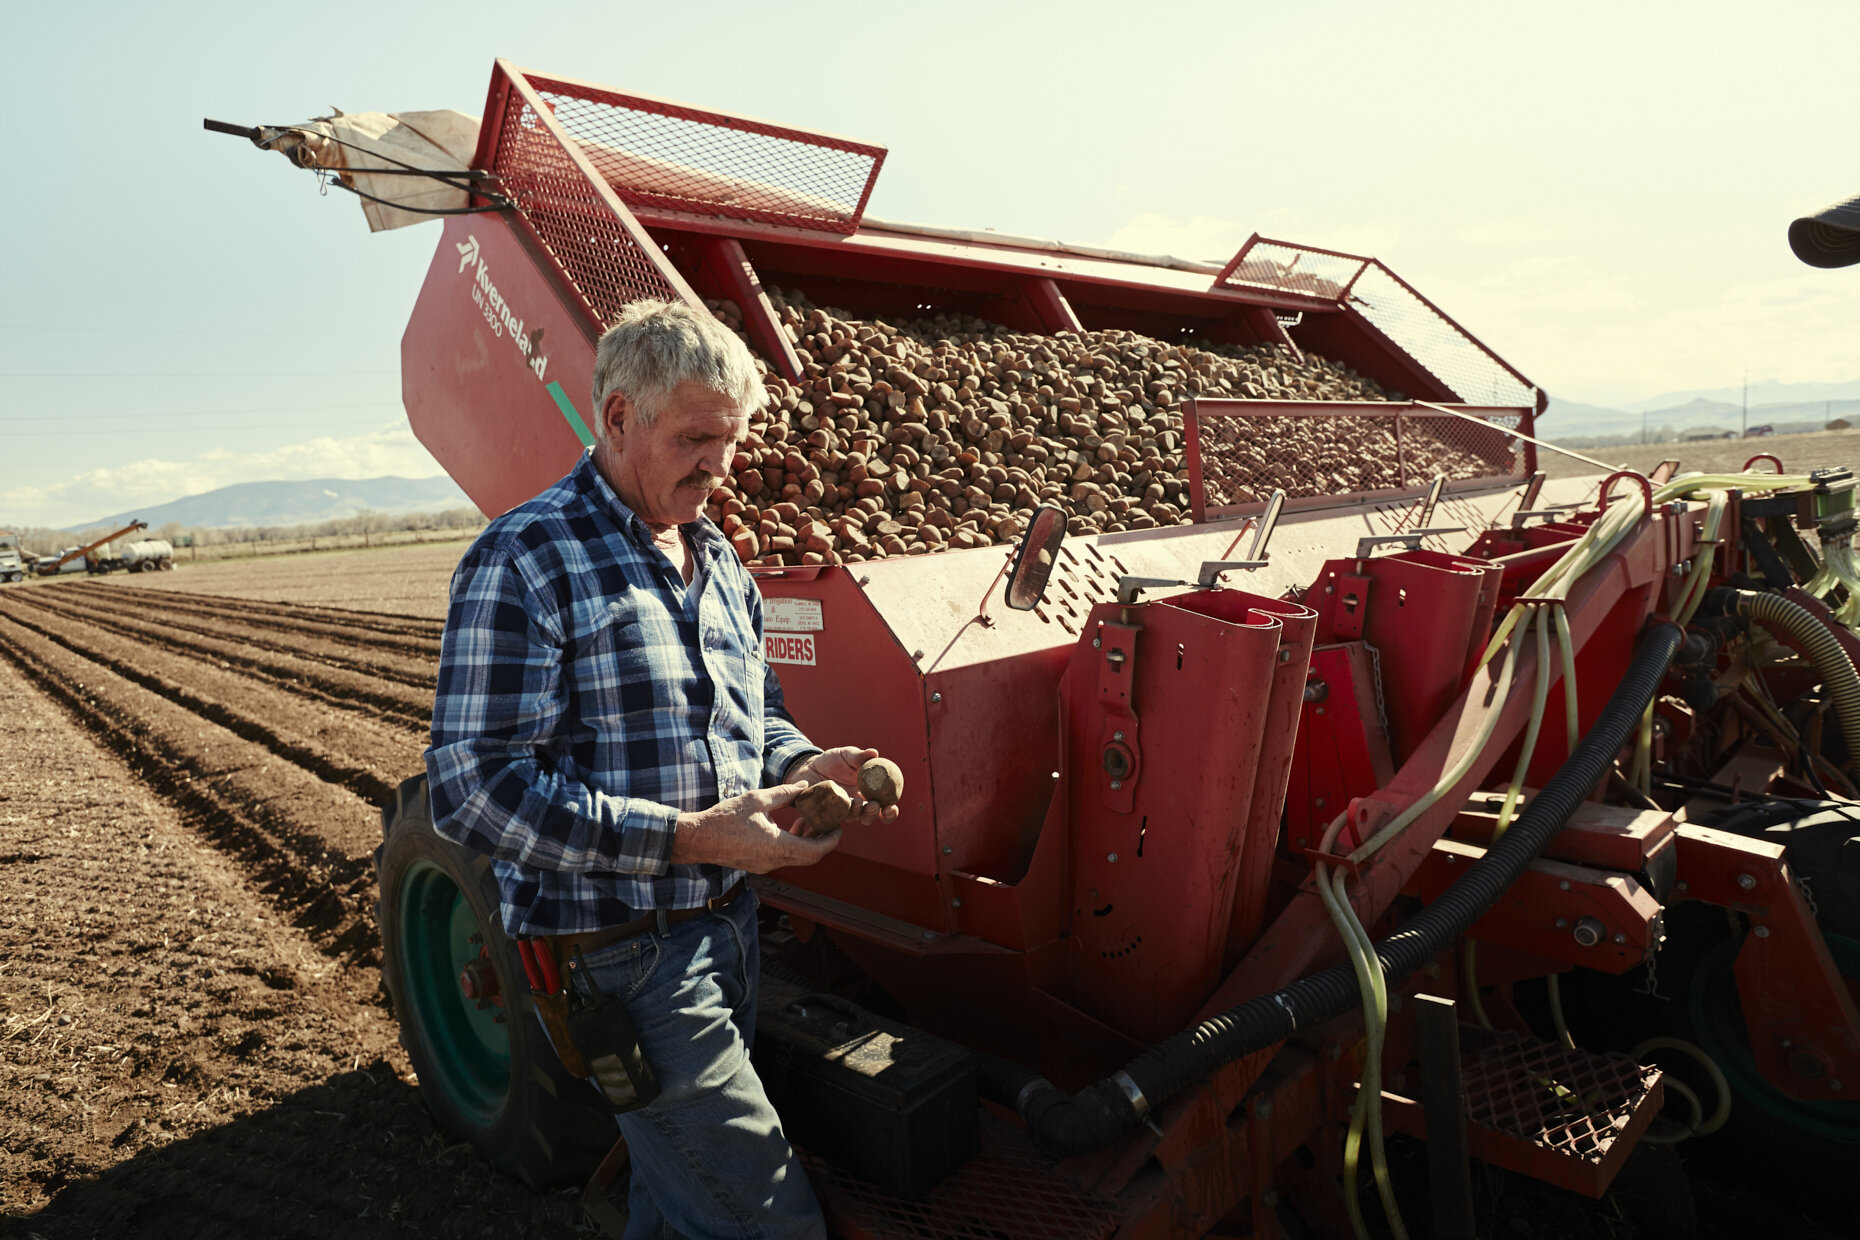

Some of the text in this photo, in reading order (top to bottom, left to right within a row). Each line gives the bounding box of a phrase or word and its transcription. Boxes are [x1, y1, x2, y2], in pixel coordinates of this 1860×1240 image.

[483, 303, 502, 337] 3300
[771, 606, 776, 614] &
[766, 637, 814, 661] RIDERS
